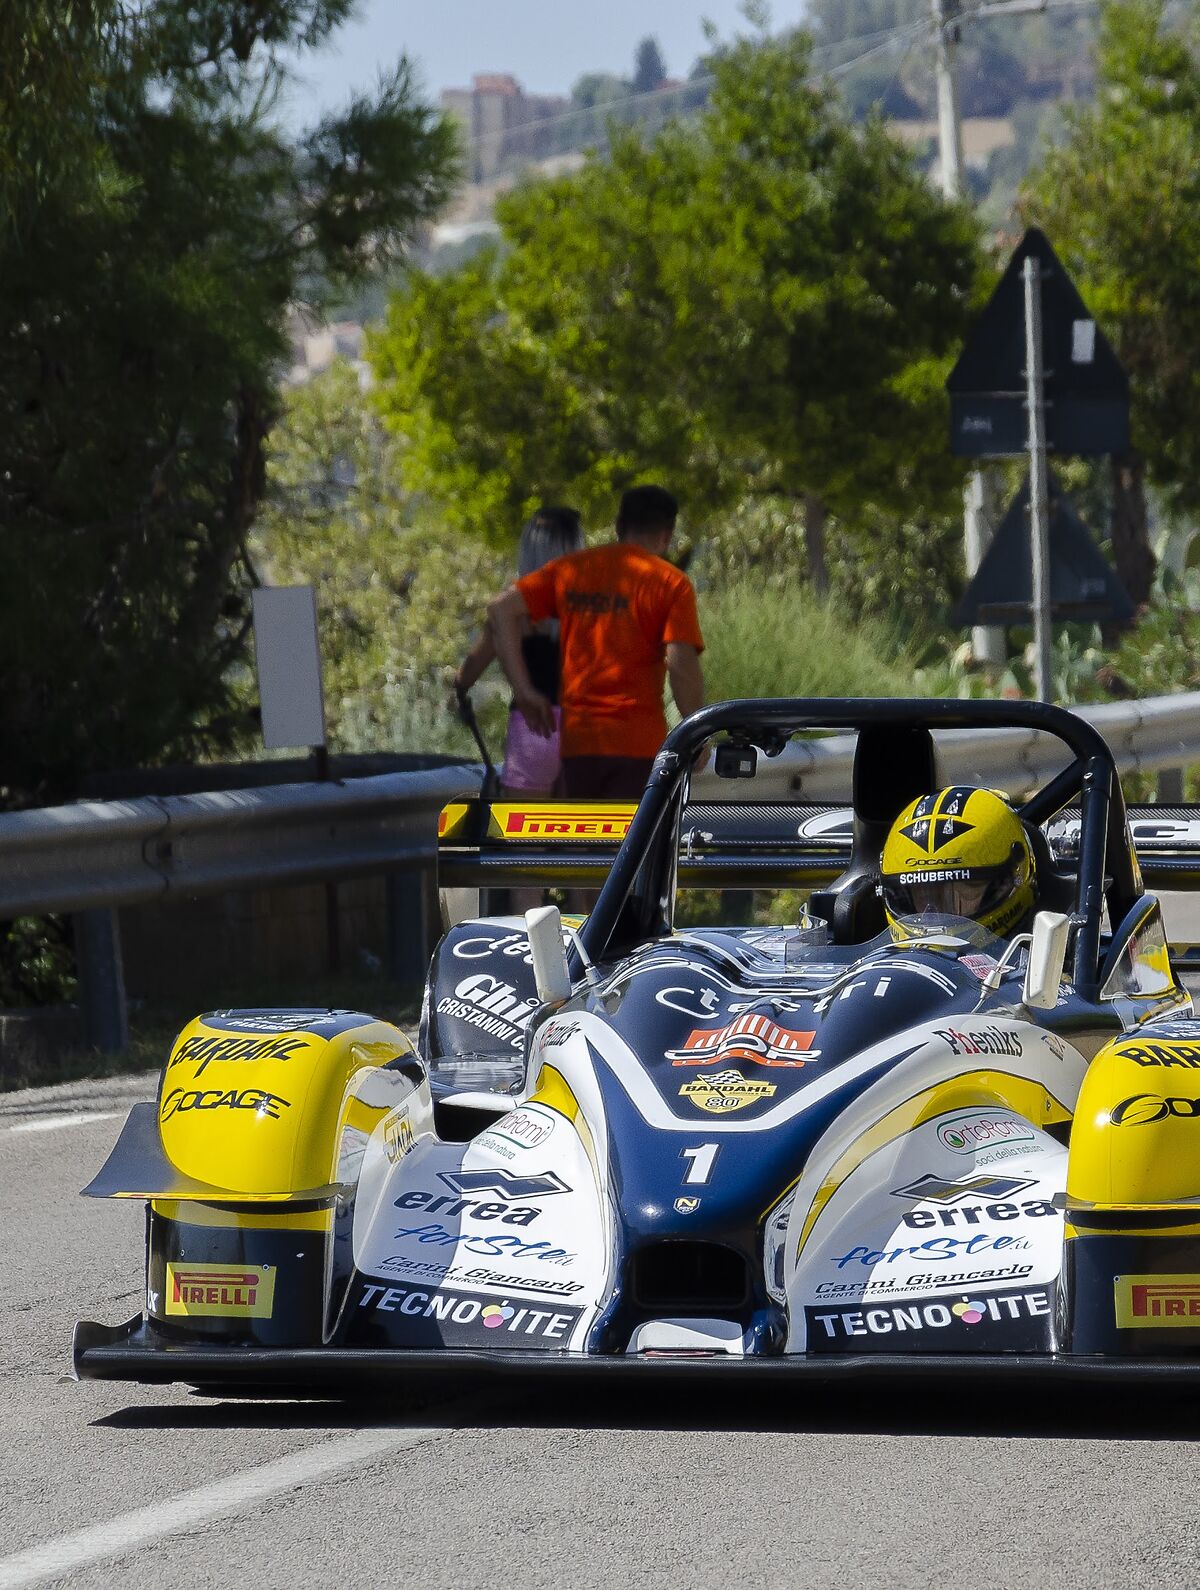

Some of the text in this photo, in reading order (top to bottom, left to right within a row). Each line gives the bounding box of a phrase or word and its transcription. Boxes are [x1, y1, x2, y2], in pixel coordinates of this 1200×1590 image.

[506, 812, 635, 834] PIREL
[900, 870, 970, 884] SCHUBERTH
[437, 997, 517, 1041] CRISTANINI
[931, 1025, 1023, 1057] Pheniks
[169, 1036, 311, 1080] BARDAHL
[685, 1084, 771, 1098] BARDAHL
[682, 1143, 720, 1184] 1
[375, 1264, 413, 1276] AGENTE
[381, 1255, 586, 1292] Carini Giancarlo
[816, 1263, 1034, 1294] Carini Giancarlo
[173, 1272, 259, 1306] PIRELLI
[815, 1289, 857, 1300] AGENTE
[869, 1283, 934, 1296] COMMERCIO
